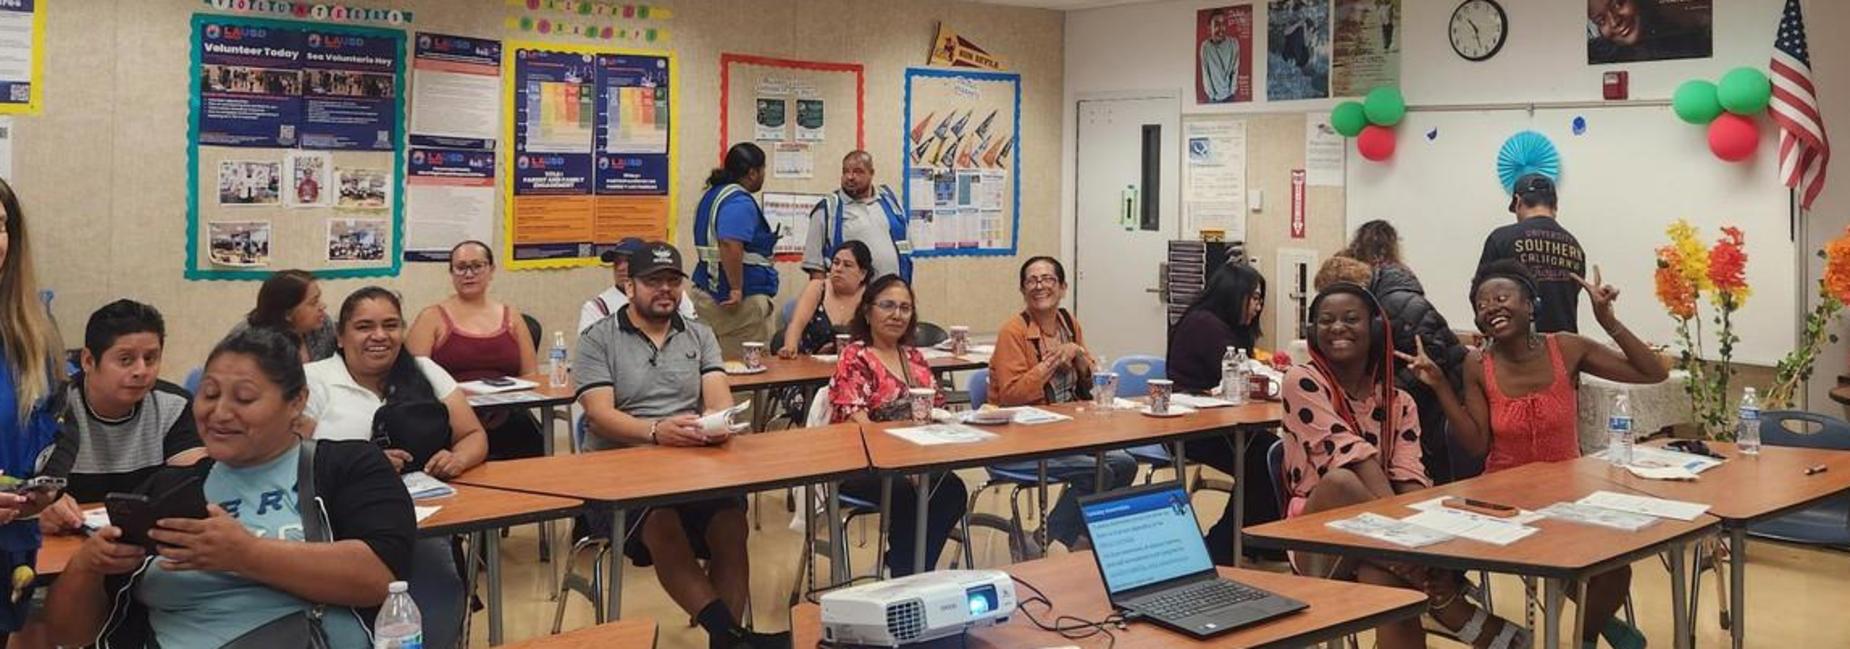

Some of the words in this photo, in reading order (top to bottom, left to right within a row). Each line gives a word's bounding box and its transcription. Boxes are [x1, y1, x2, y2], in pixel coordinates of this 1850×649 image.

[204, 42, 262, 55] Volunteer
[264, 48, 300, 60] Today
[1515, 239, 1583, 262] SOUTHERN
